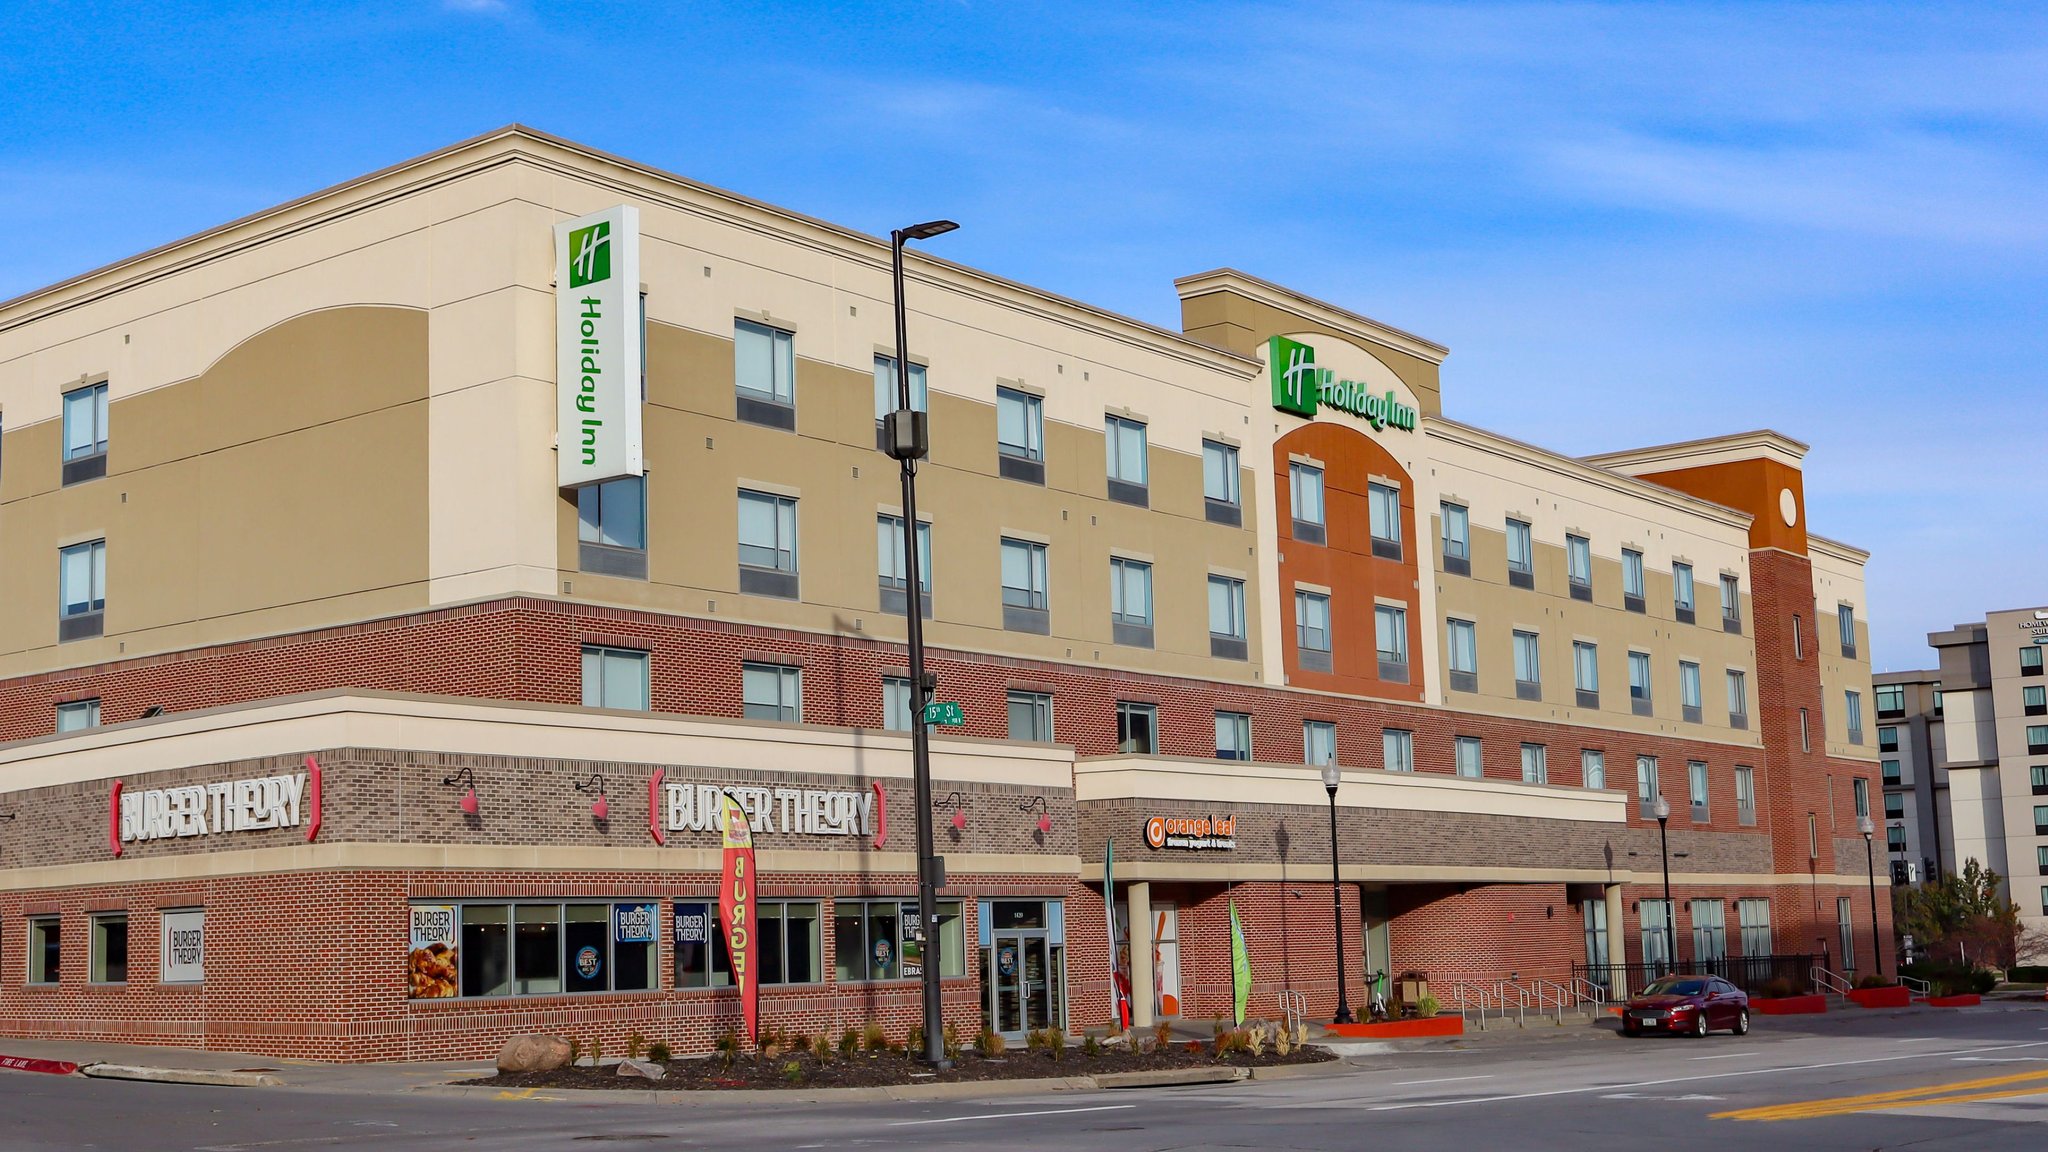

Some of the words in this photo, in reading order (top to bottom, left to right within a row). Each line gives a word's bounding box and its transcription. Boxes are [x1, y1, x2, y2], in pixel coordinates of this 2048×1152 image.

[576, 295, 601, 413] Holiday
[1317, 368, 1388, 429] Holiday
[1388, 391, 1416, 430] Inn
[581, 419, 602, 466] Inn
[945, 705, 954, 717] St
[122, 784, 209, 842] BURGER
[208, 773, 307, 834] THEORY
[665, 783, 774, 833] BURER
[775, 788, 873, 836] THEORY
[1166, 818, 1211, 837] orange
[1211, 814, 1236, 836] leaf
[1188, 836, 1211, 849] yogurt
[413, 911, 450, 926] BURGER
[620, 911, 650, 925] BURGER
[675, 915, 703, 928] BURGER
[173, 930, 201, 947] BURGER
[413, 926, 450, 941] THEORY
[620, 925, 650, 938] THEORY
[675, 928, 703, 941] THEORY
[173, 947, 201, 964] THEORY
